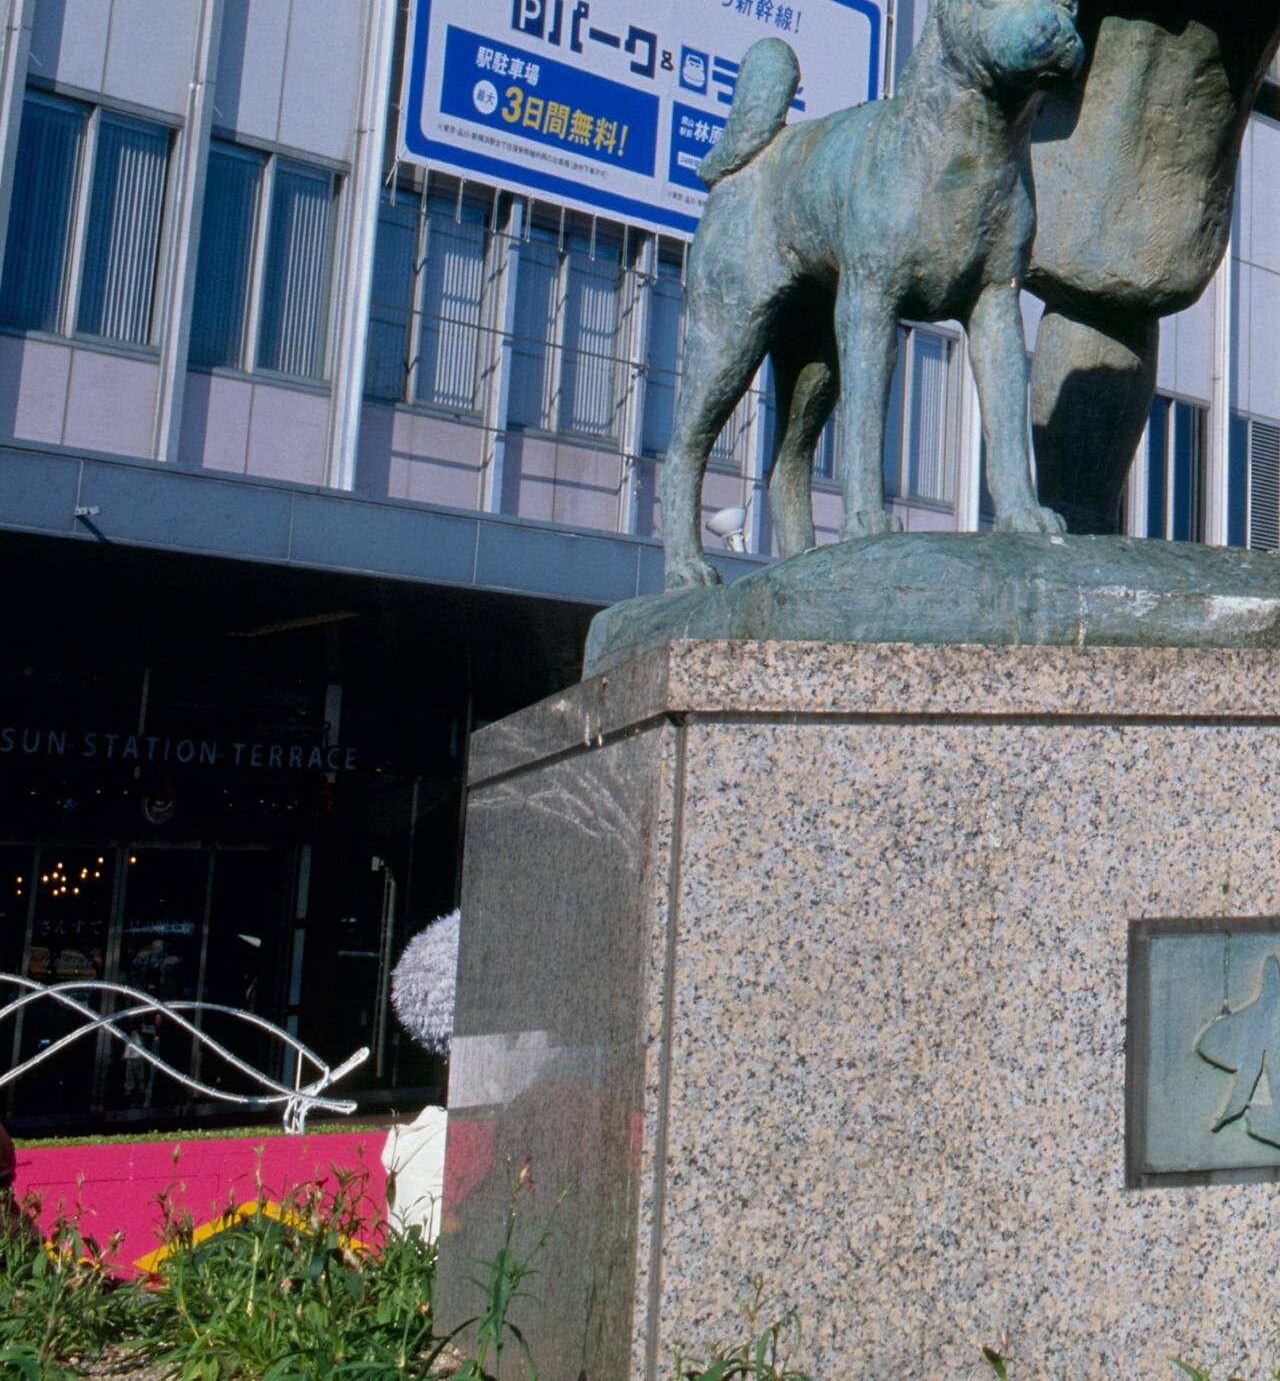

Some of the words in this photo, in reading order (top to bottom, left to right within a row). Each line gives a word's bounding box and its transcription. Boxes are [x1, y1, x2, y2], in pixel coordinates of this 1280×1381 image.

[475, 46, 540, 86] 駅駐車場
[475, 86, 496, 106] 最大
[501, 84, 628, 157] 3日間無料!
[0, 726, 67, 756] SUN
[81, 731, 217, 765] STATION
[232, 742, 360, 771] TERRACE
